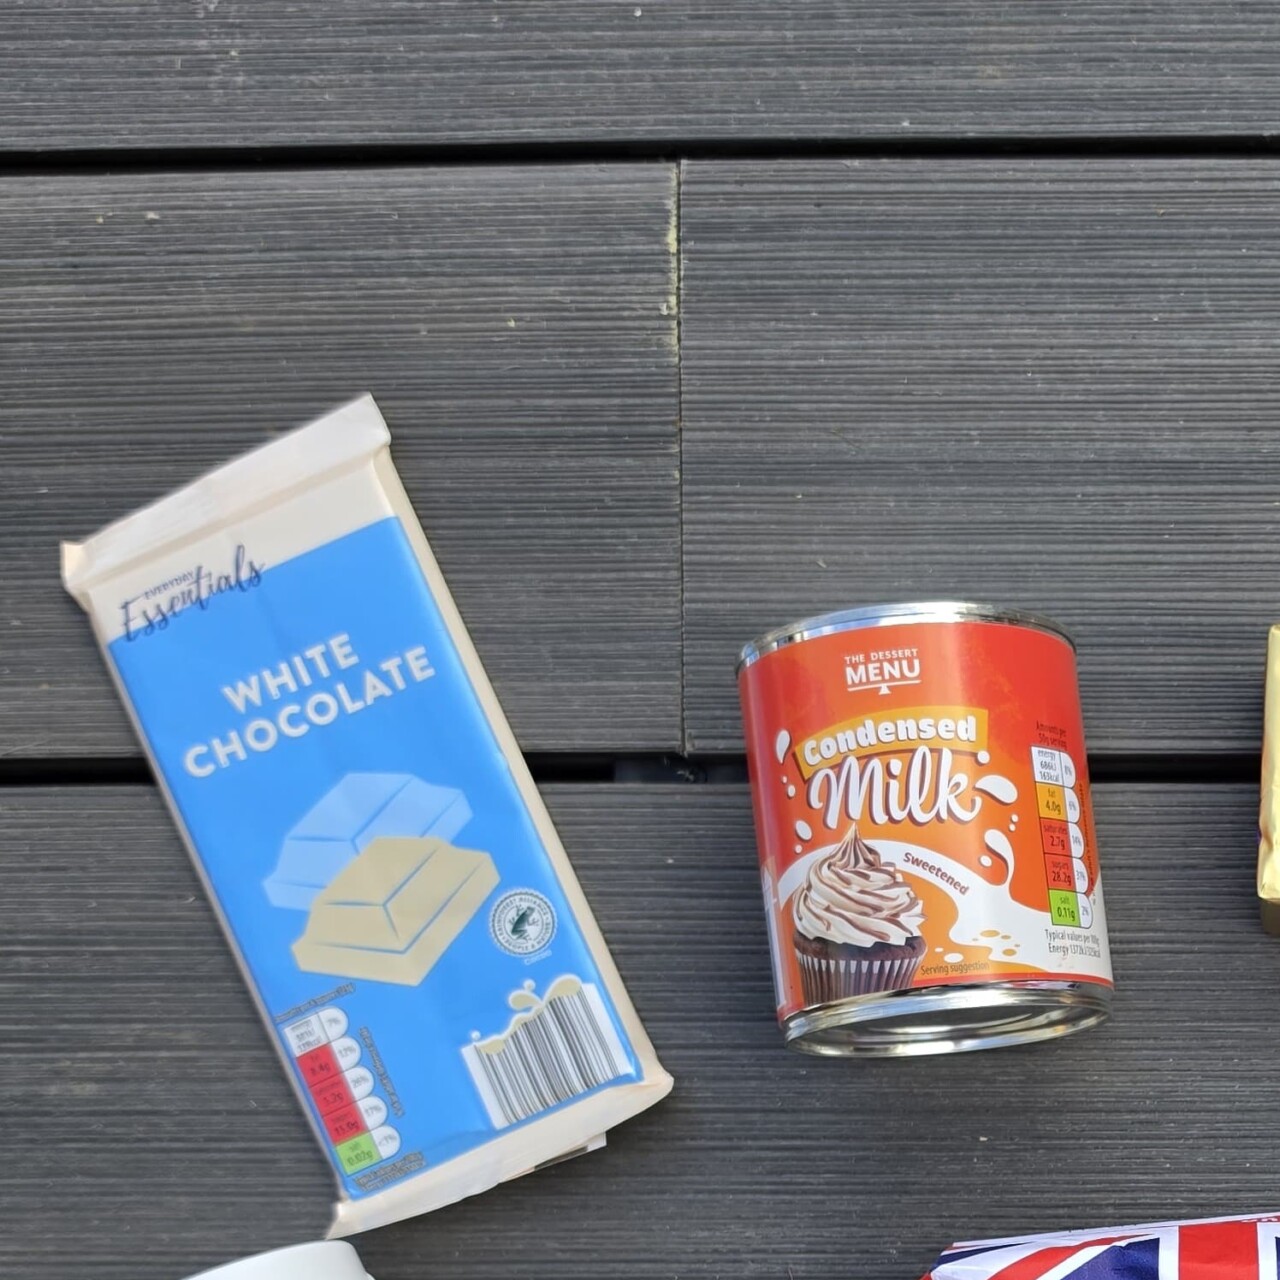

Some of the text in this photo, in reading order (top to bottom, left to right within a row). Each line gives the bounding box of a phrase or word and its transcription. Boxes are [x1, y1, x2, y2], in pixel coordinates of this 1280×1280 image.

[120, 545, 265, 642] Essentials
[144, 571, 194, 599] EVERYDAY
[844, 648, 918, 665] THE DESSERT
[221, 633, 359, 714] WHITE
[845, 659, 921, 685] MENU
[183, 645, 436, 777] CHOCOLATE
[803, 716, 977, 766] Condensed
[808, 745, 983, 830] Milk
[1046, 801, 1061, 816] 4.0g
[1050, 835, 1065, 849] 2.7g
[1052, 871, 1072, 887] 28.2g
[1057, 906, 1076, 921] 0.11g
[920, 961, 990, 976] Serving suggestion
